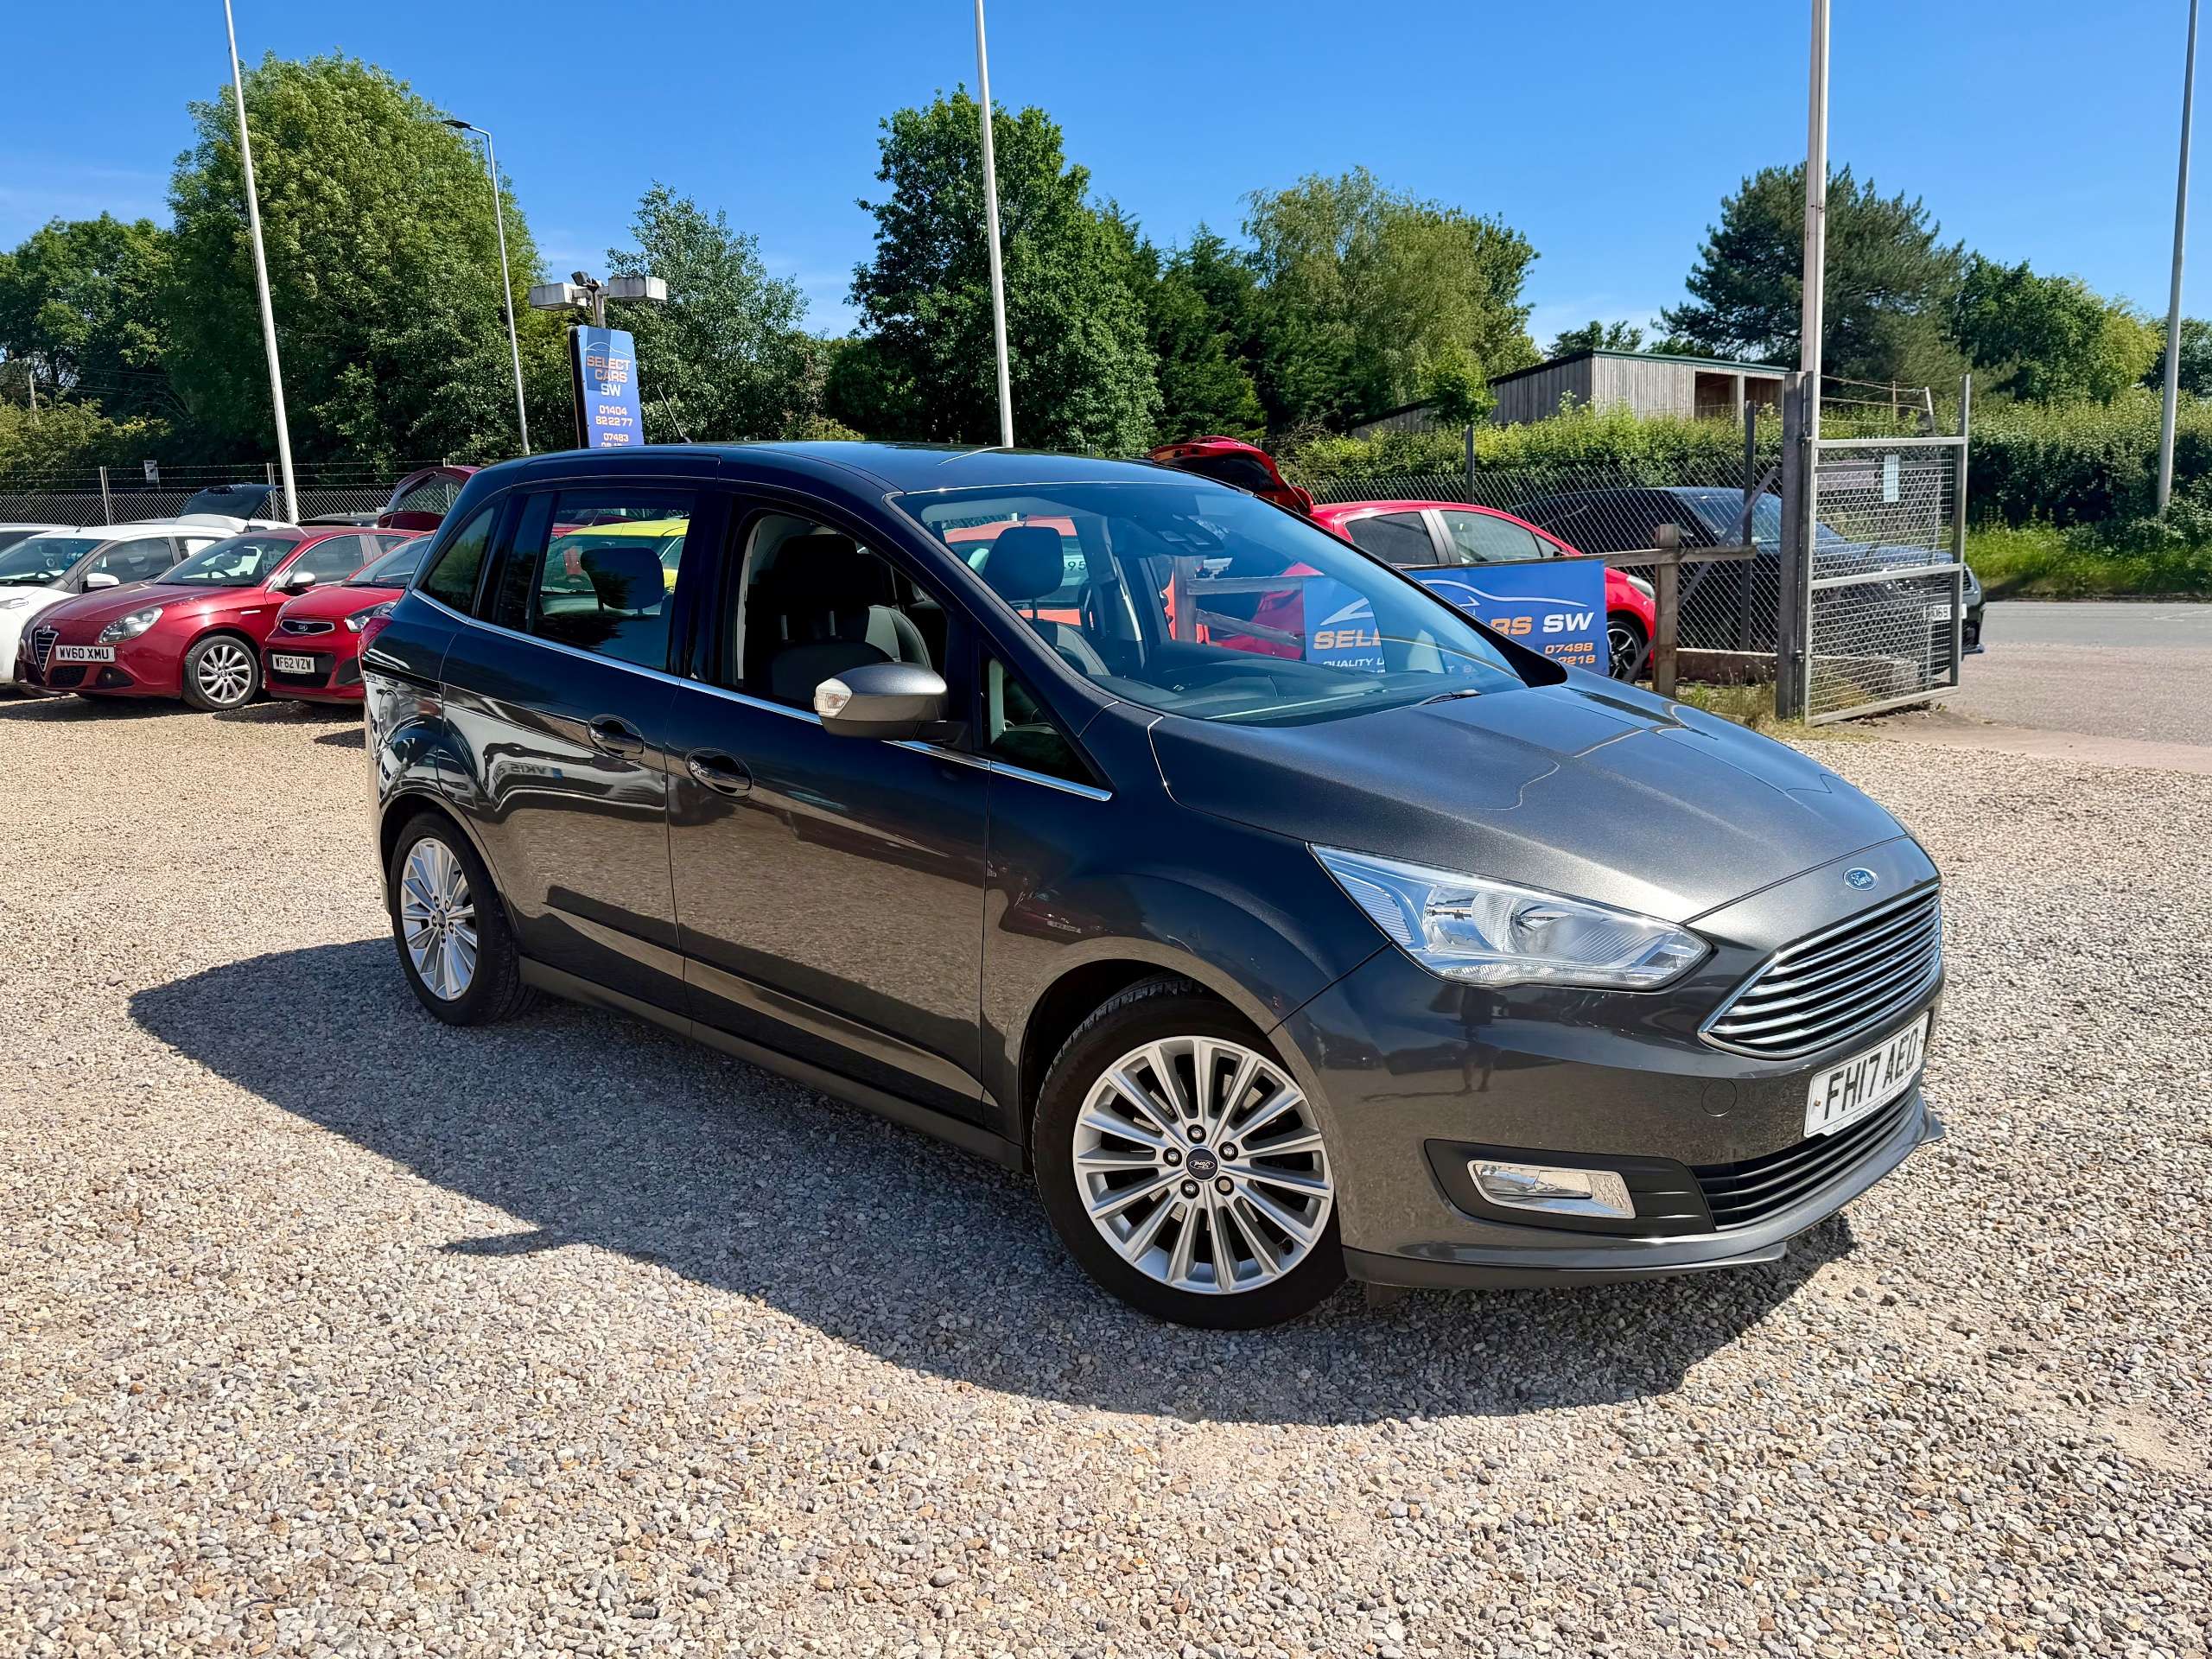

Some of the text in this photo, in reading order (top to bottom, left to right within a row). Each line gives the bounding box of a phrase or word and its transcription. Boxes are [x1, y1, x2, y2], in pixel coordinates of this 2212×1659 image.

[587, 355, 631, 371] SELECT
[595, 369, 628, 384] CARS
[601, 383, 621, 397] SW
[599, 404, 627, 416] 01404
[1542, 612, 1595, 633] SW
[59, 647, 110, 660] WV60 XMU
[275, 656, 311, 671] WF62 VZW
[1823, 1051, 1883, 1121] FH17
